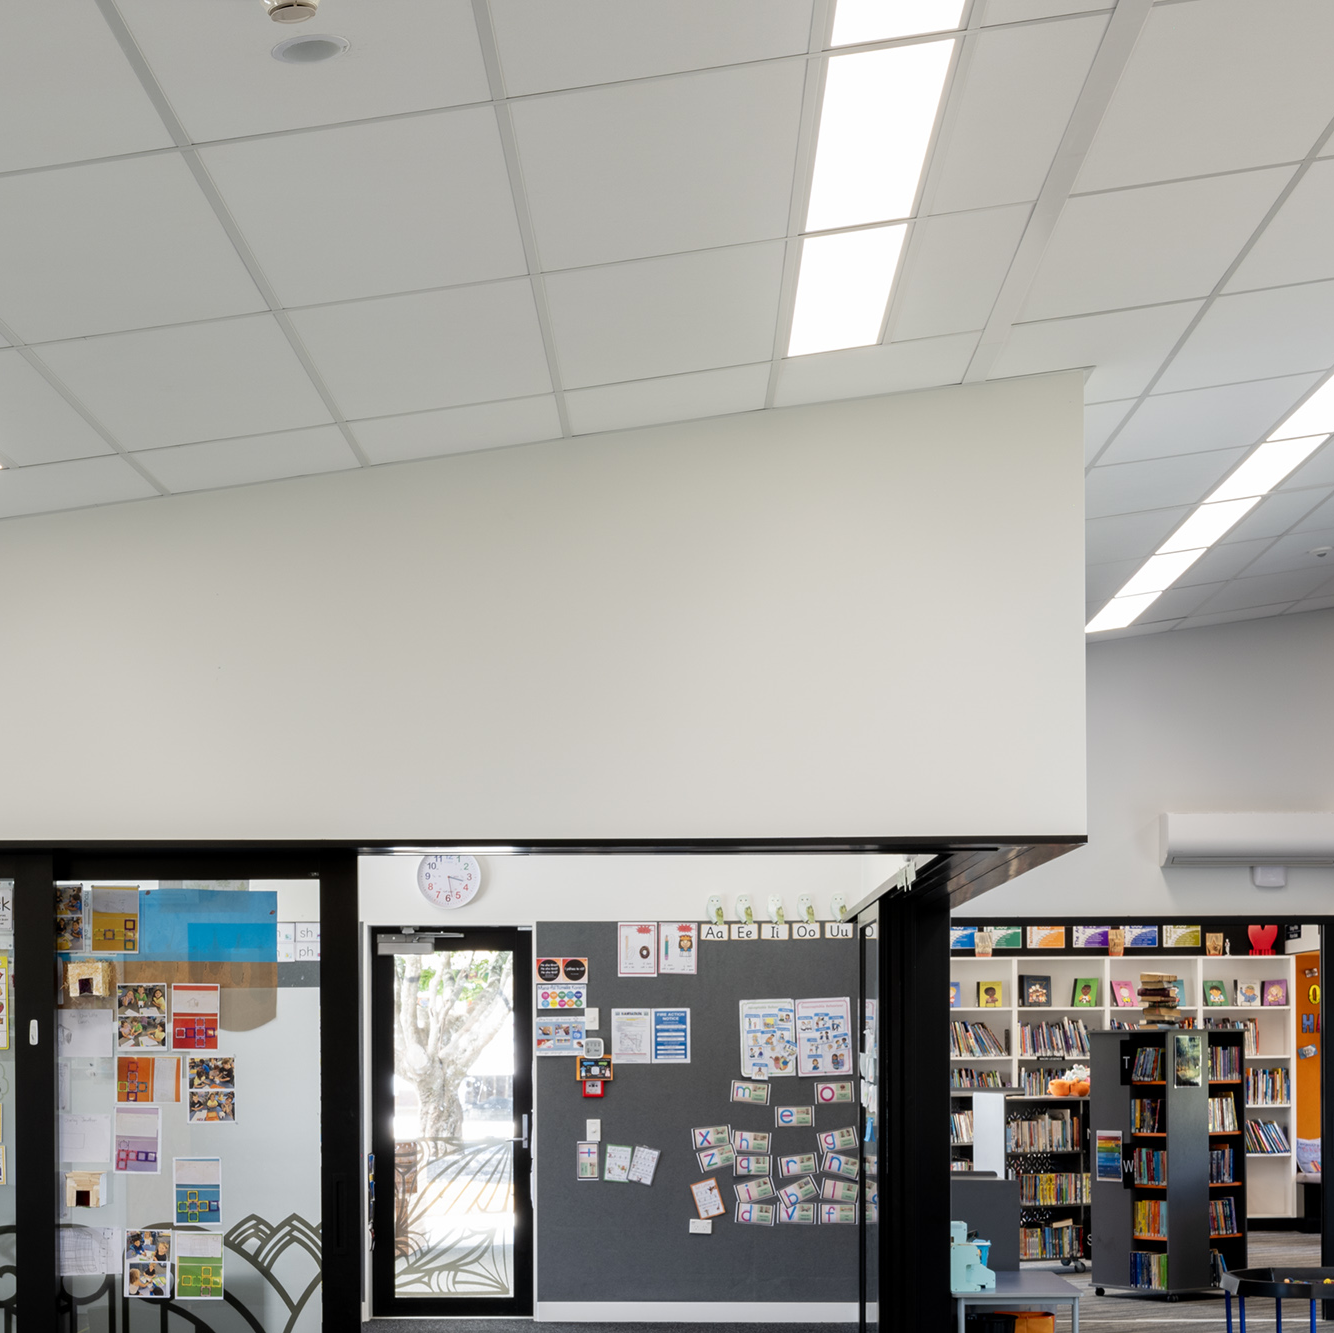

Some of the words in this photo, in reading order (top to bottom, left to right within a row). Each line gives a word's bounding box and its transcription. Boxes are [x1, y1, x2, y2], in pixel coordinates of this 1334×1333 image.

[300, 927, 313, 939] sh
[705, 927, 724, 939] Aa
[737, 926, 752, 938] Ee
[771, 926, 779, 938] Ii
[796, 925, 816, 938] Oo
[830, 925, 849, 937] Uu
[299, 946, 315, 959] ph
